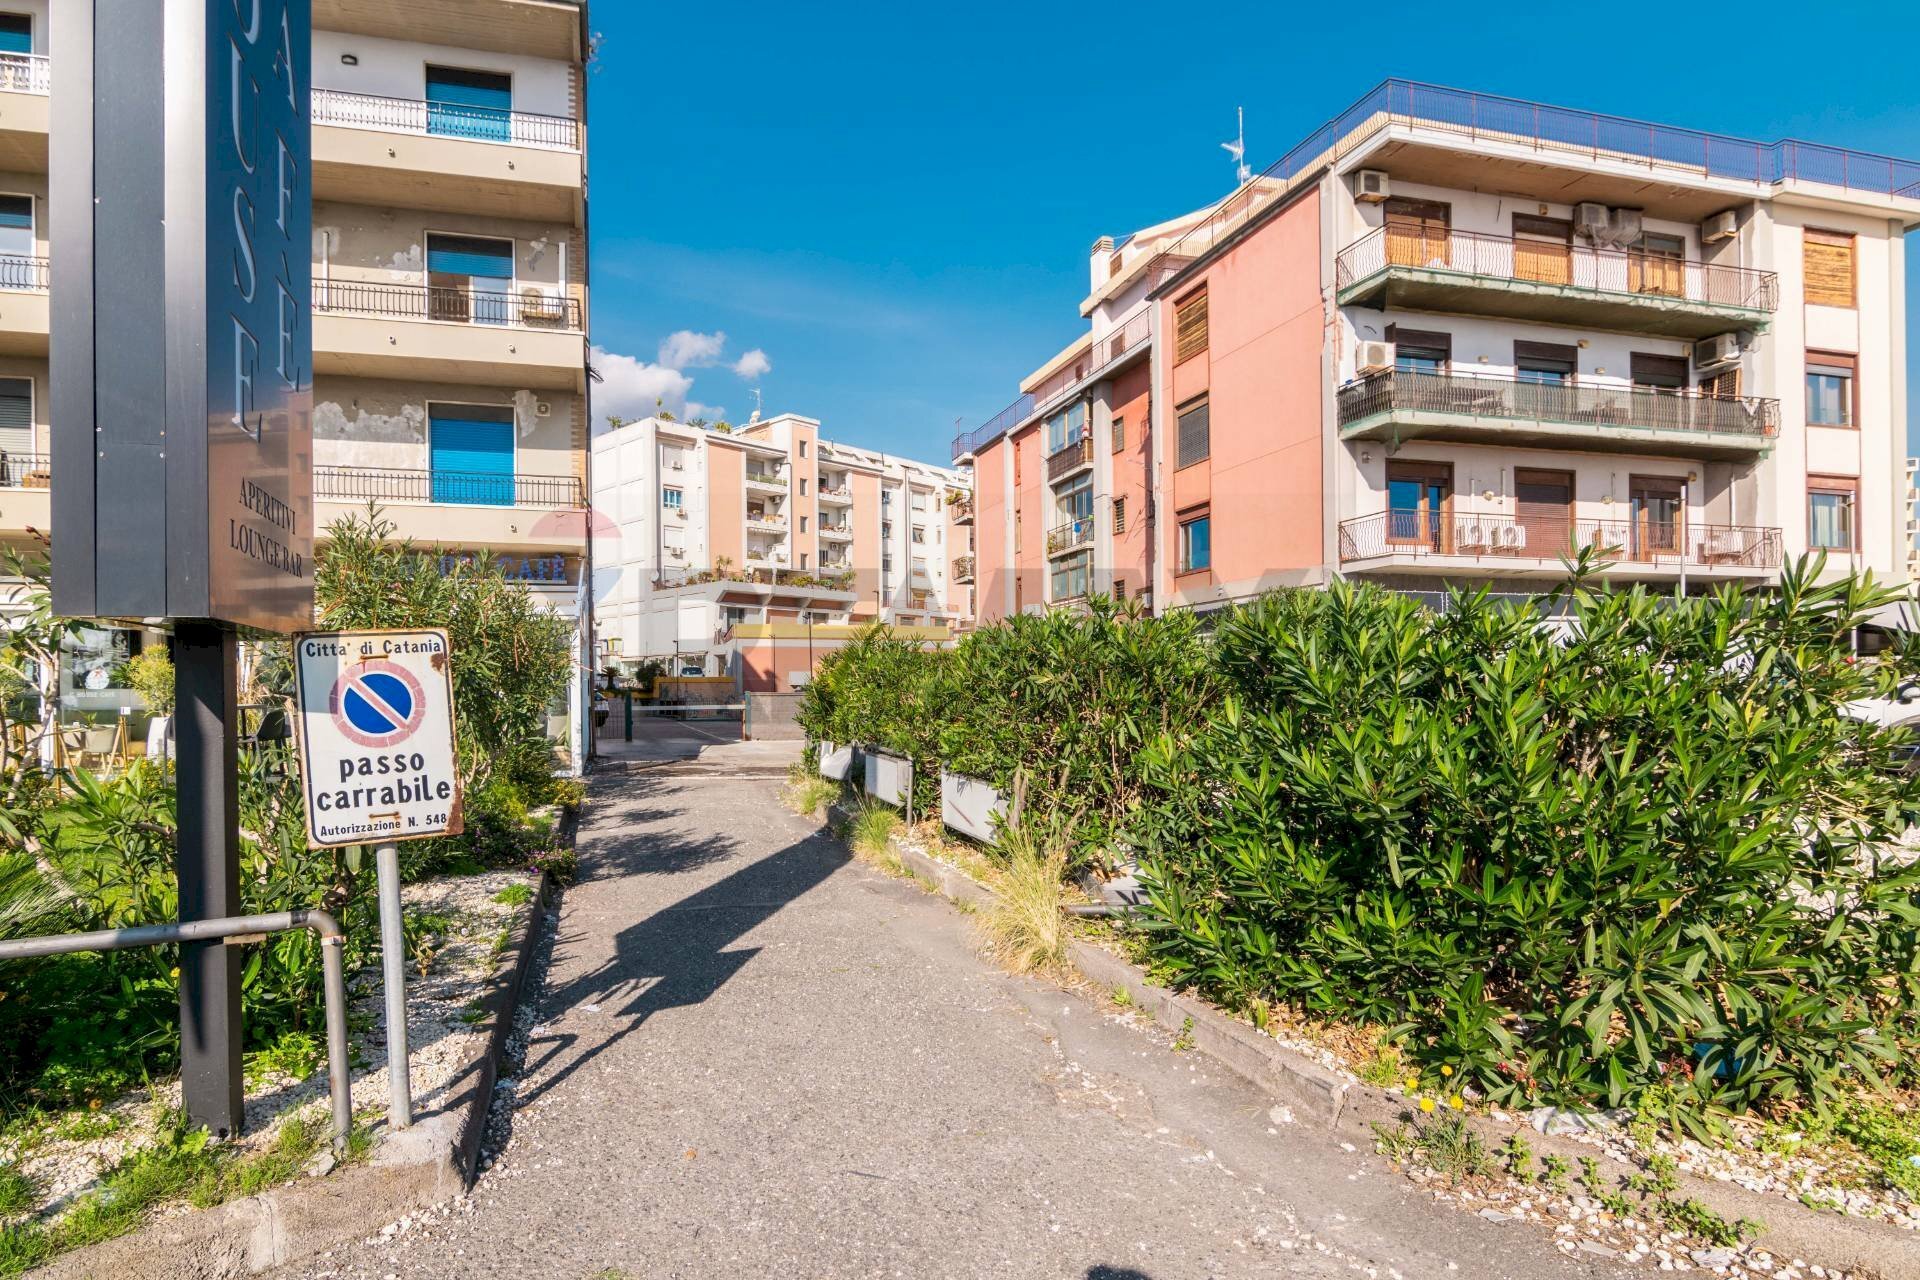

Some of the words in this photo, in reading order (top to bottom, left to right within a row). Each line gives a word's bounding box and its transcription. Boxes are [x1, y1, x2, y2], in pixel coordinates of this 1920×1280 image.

[238, 476, 297, 536] APERITIVI
[230, 518, 281, 569] LOUNGE
[283, 546, 303, 579] BAR
[360, 641, 373, 655] di
[383, 640, 441, 655] Catania
[339, 752, 425, 784] passo
[316, 774, 451, 812] carrabile
[320, 819, 401, 837] Autorizzazione
[408, 816, 419, 828] N.
[425, 813, 447, 826] 548
